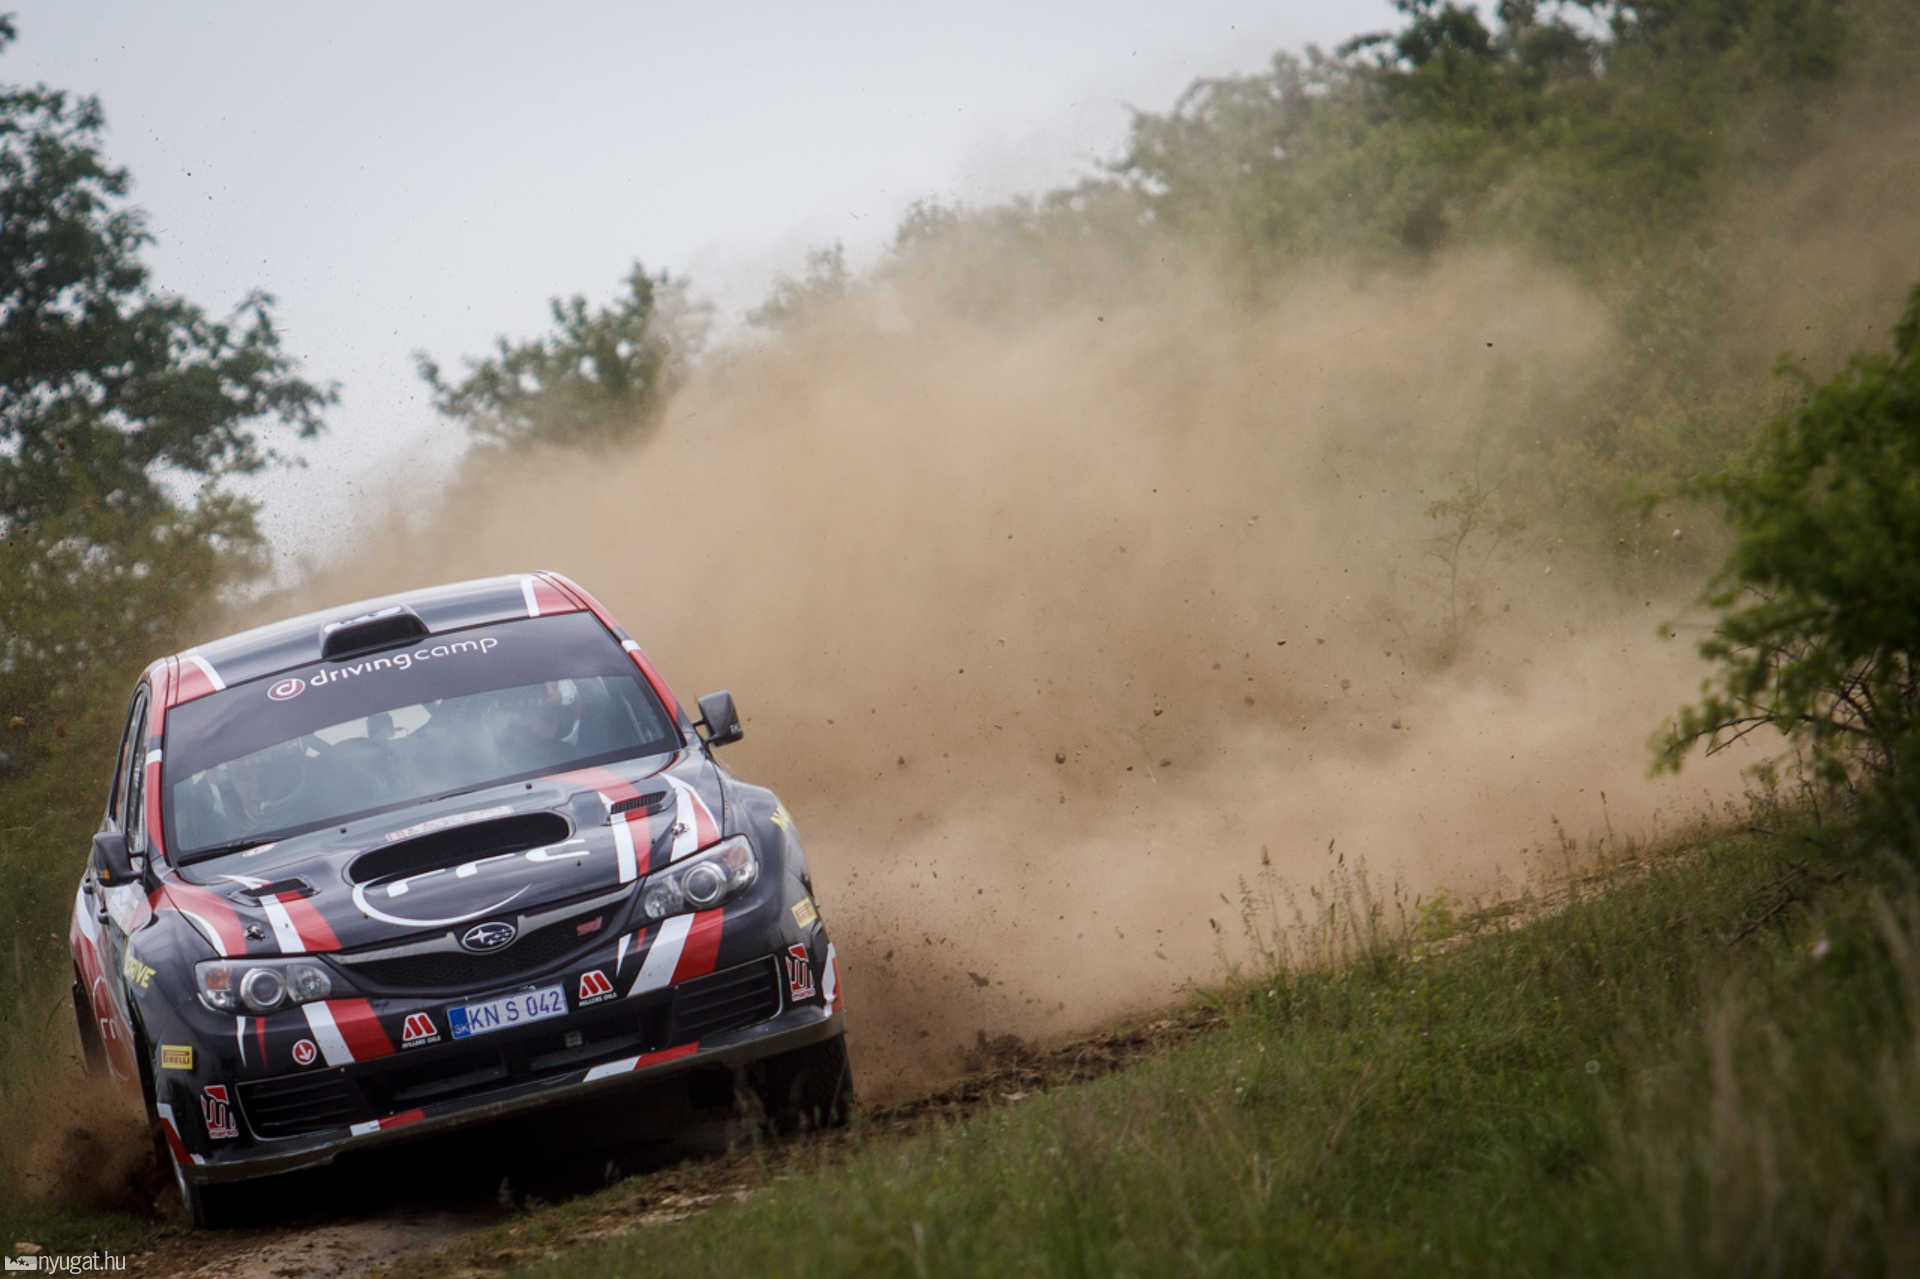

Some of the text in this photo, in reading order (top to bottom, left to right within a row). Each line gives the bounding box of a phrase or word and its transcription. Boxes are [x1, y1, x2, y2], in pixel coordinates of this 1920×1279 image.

[310, 637, 498, 687] drivingcamp
[454, 1023, 469, 1034] SK
[469, 1006, 500, 1029] KN
[506, 1002, 520, 1022] S
[526, 990, 563, 1017] 042
